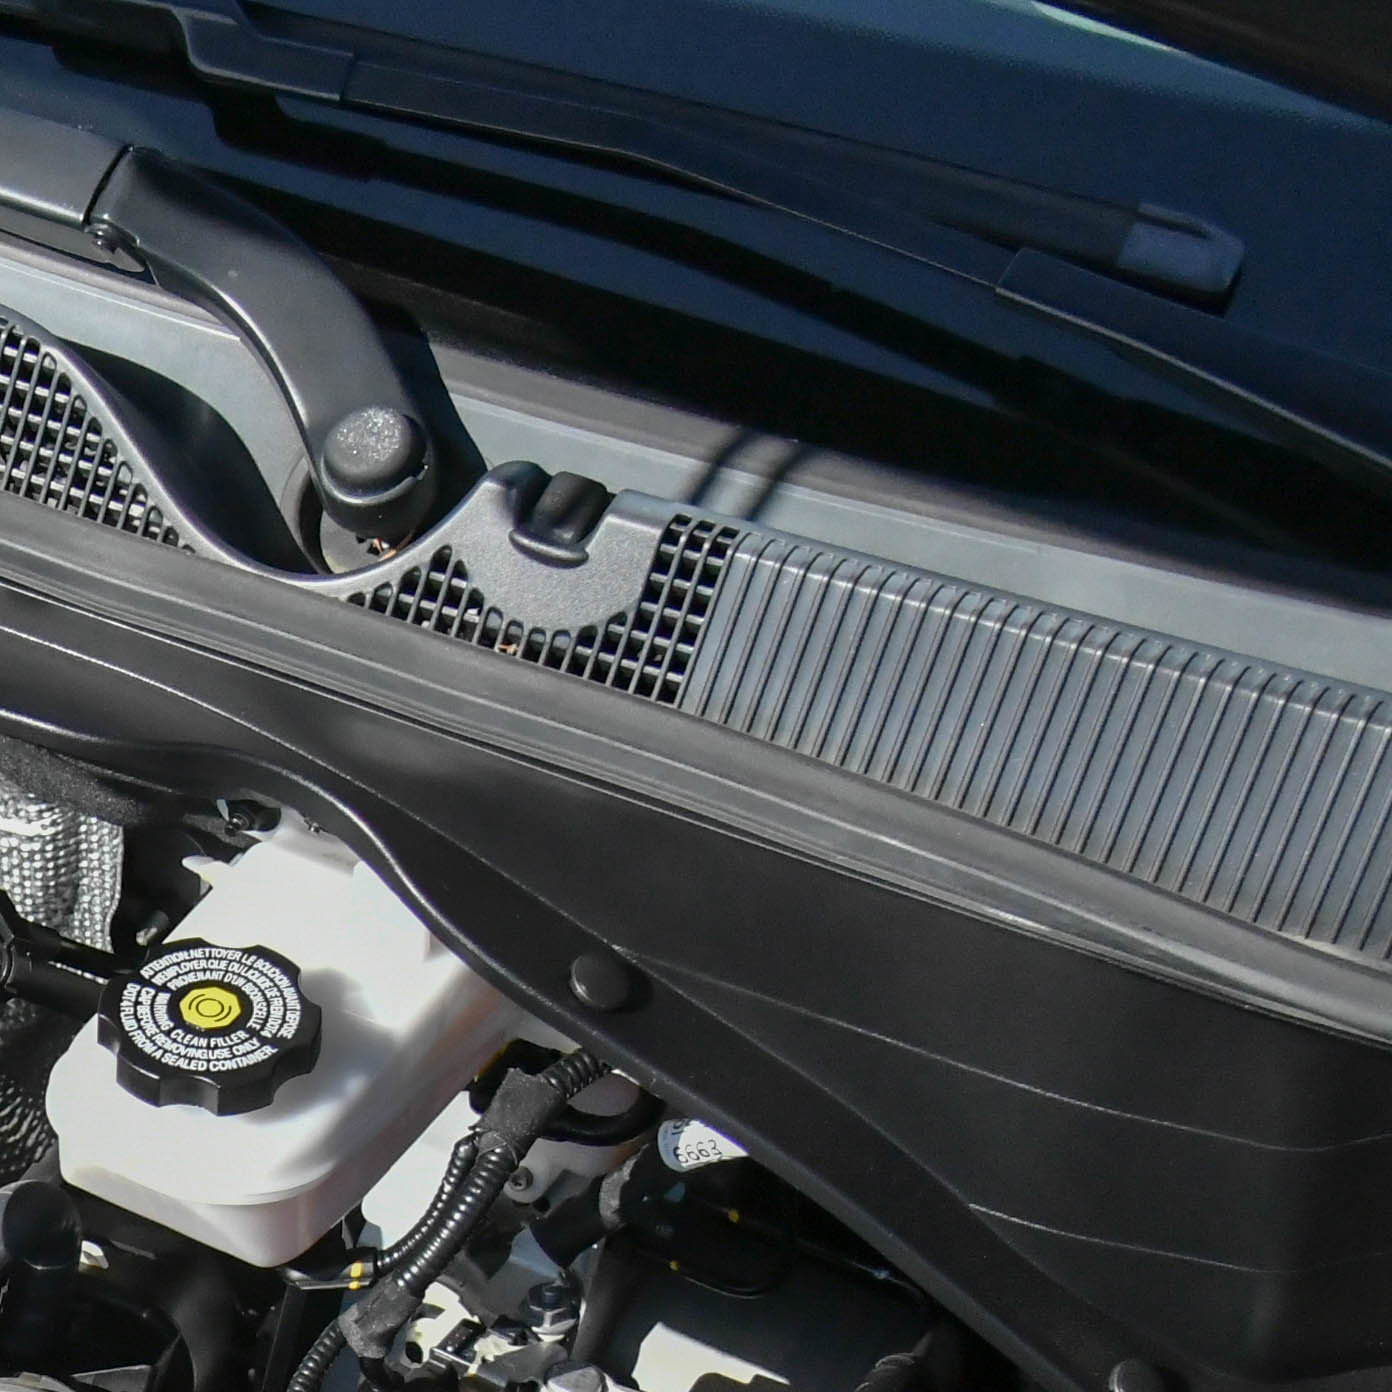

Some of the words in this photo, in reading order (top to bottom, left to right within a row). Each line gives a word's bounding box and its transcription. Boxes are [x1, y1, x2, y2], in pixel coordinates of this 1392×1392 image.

[170, 1029, 209, 1047] CLEAN
[210, 1030, 250, 1048] FILLER
[231, 1036, 261, 1056] ONLY
[128, 1029, 158, 1054] FROM
[151, 1048, 164, 1060] A
[161, 1052, 208, 1071] SEALED
